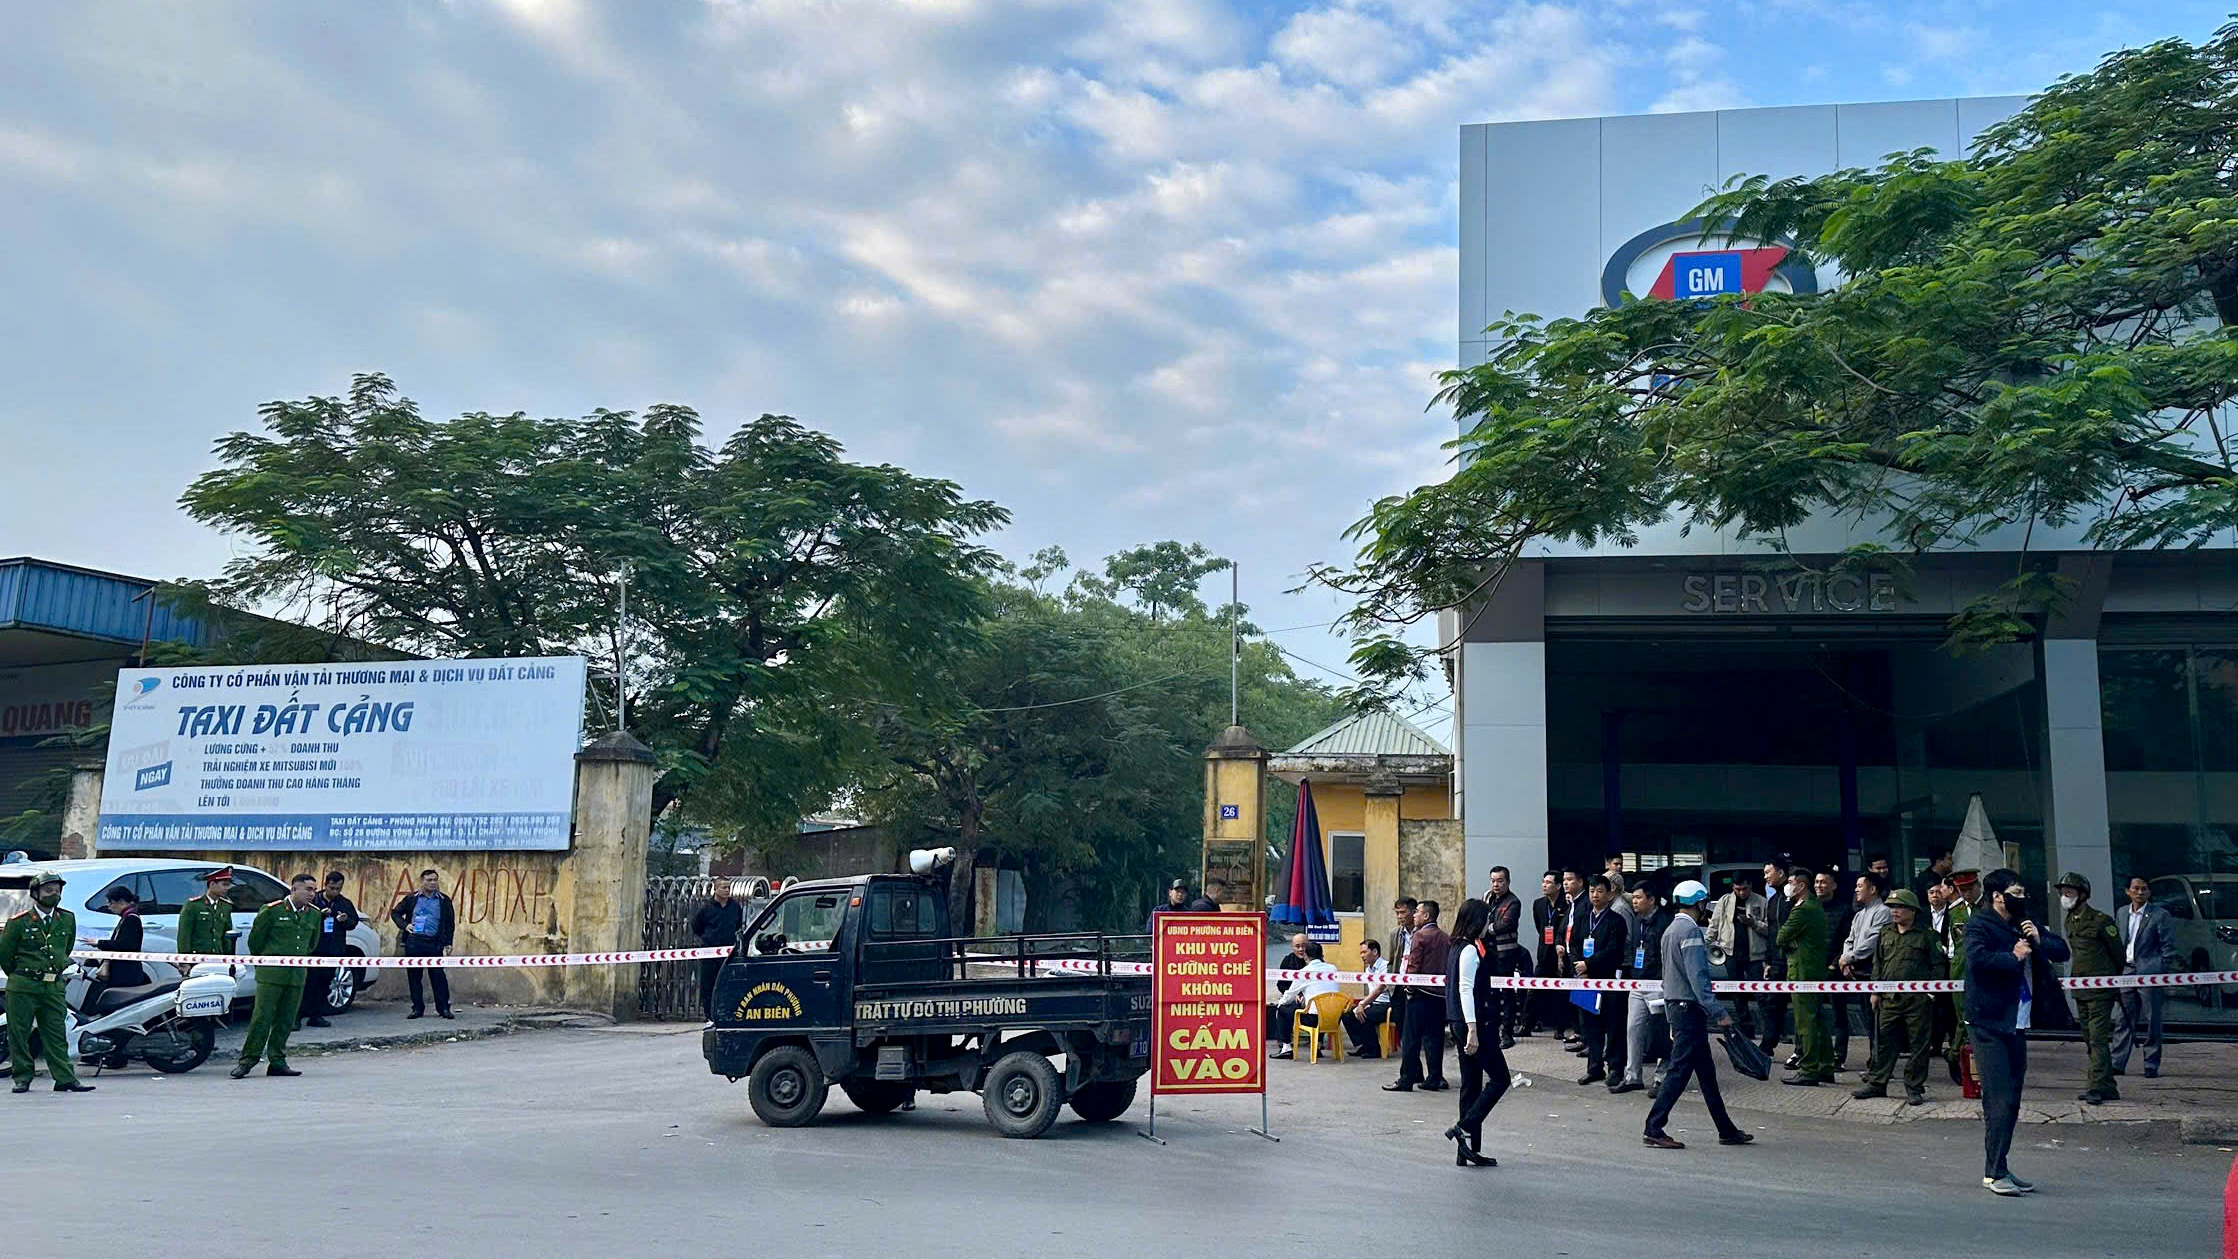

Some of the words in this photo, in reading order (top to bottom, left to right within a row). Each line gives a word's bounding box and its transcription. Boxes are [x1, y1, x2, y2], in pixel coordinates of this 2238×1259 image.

[1688, 267, 1724, 292] GM
[1683, 573, 1896, 613] SERVICE
[172, 673, 205, 689] CÔNG
[209, 675, 223, 688] TY
[226, 669, 245, 688] CỔ
[246, 669, 281, 688] PHẦN
[284, 668, 309, 689] VẬN
[313, 666, 333, 685] TẢI
[336, 669, 386, 685] THƯƠNG
[389, 669, 415, 686] MẠI
[418, 669, 428, 683] &
[433, 668, 464, 686] DỊCH
[468, 667, 485, 684] VỤ
[488, 663, 515, 682] ĐẤT
[517, 662, 555, 680] CẢNG
[3, 700, 91, 734] QUANG
[178, 704, 247, 740] TAXI
[252, 690, 320, 739] ĐẤT
[327, 694, 414, 738] CẢNG
[204, 743, 233, 755] LƯƠNG
[290, 743, 319, 754] DOANH
[321, 742, 339, 753] THU
[202, 760, 222, 772] TRẢI
[223, 760, 258, 773] NGHIỆM
[259, 761, 271, 772] XE
[272, 760, 318, 772] MITSUBISI
[319, 759, 337, 771] MỚI
[139, 767, 168, 787] NGAY
[200, 776, 234, 790] THƯỞNG
[236, 778, 265, 789] DOANH
[266, 778, 284, 789] THU
[286, 778, 303, 789] CAO
[198, 795, 216, 807] LÊN
[217, 795, 230, 807] TỚI
[1223, 806, 1236, 817] 26
[102, 823, 121, 840] CÔNG
[122, 826, 131, 840] TY
[164, 823, 180, 843] VẬN
[181, 822, 193, 840] TẢI
[193, 825, 222, 840] THƯƠNG
[223, 826, 237, 842] MẠI
[239, 826, 247, 840] &
[247, 826, 264, 842] DỊCH
[265, 826, 276, 843] VỤ
[276, 822, 292, 840] ĐẤT
[292, 822, 313, 840] CẢNG
[1167, 925, 1189, 936] UBND
[1190, 925, 1222, 936] PHƯỜNG
[1222, 926, 1234, 936] AN
[1175, 942, 1206, 955] KHU
[1210, 941, 1240, 958] VỰC
[1167, 960, 1219, 976] CƯỠNG
[1222, 959, 1252, 976] CHẾ
[1181, 980, 1233, 996] KHÔNG
[185, 1000, 210, 1010] CẢNH
[740, 991, 754, 1008] BAN
[745, 1008, 762, 1020] AN
[763, 1005, 790, 1020] BIÊN
[854, 1001, 891, 1022] TRẬT
[892, 1001, 913, 1021] TỰ
[913, 1000, 934, 1018] ĐÔ
[935, 1001, 961, 1019] THỊ
[962, 997, 1027, 1015] PHƯỜNG
[1170, 1000, 1220, 1019] NHIỆM
[1224, 1003, 1244, 1019] VỤ
[1169, 1022, 1250, 1051] CẤM
[1169, 1053, 1250, 1080] VÀO
